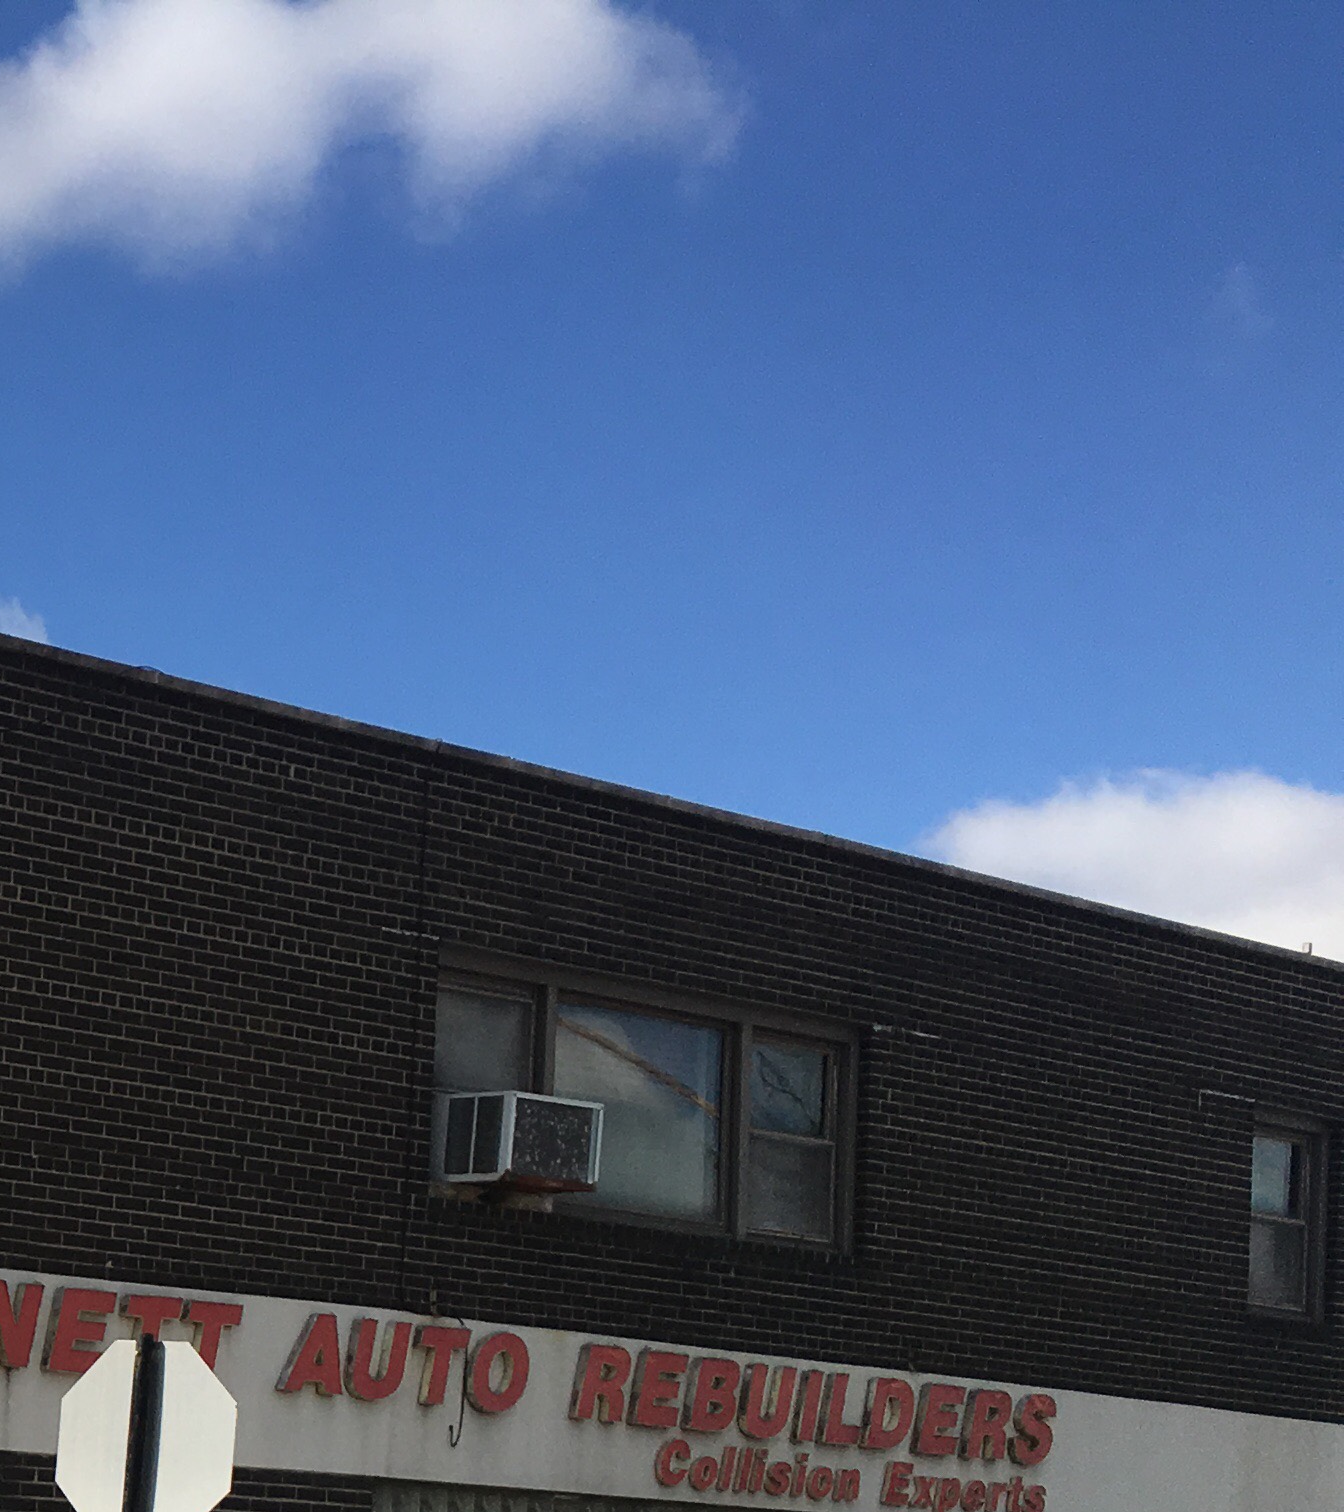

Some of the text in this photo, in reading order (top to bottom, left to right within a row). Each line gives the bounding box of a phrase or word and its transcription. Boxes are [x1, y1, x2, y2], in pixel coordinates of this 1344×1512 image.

[276, 1312, 530, 1414] AUTO
[568, 1342, 1057, 1467] REBUILDERS
[654, 1438, 861, 1503] Collision
